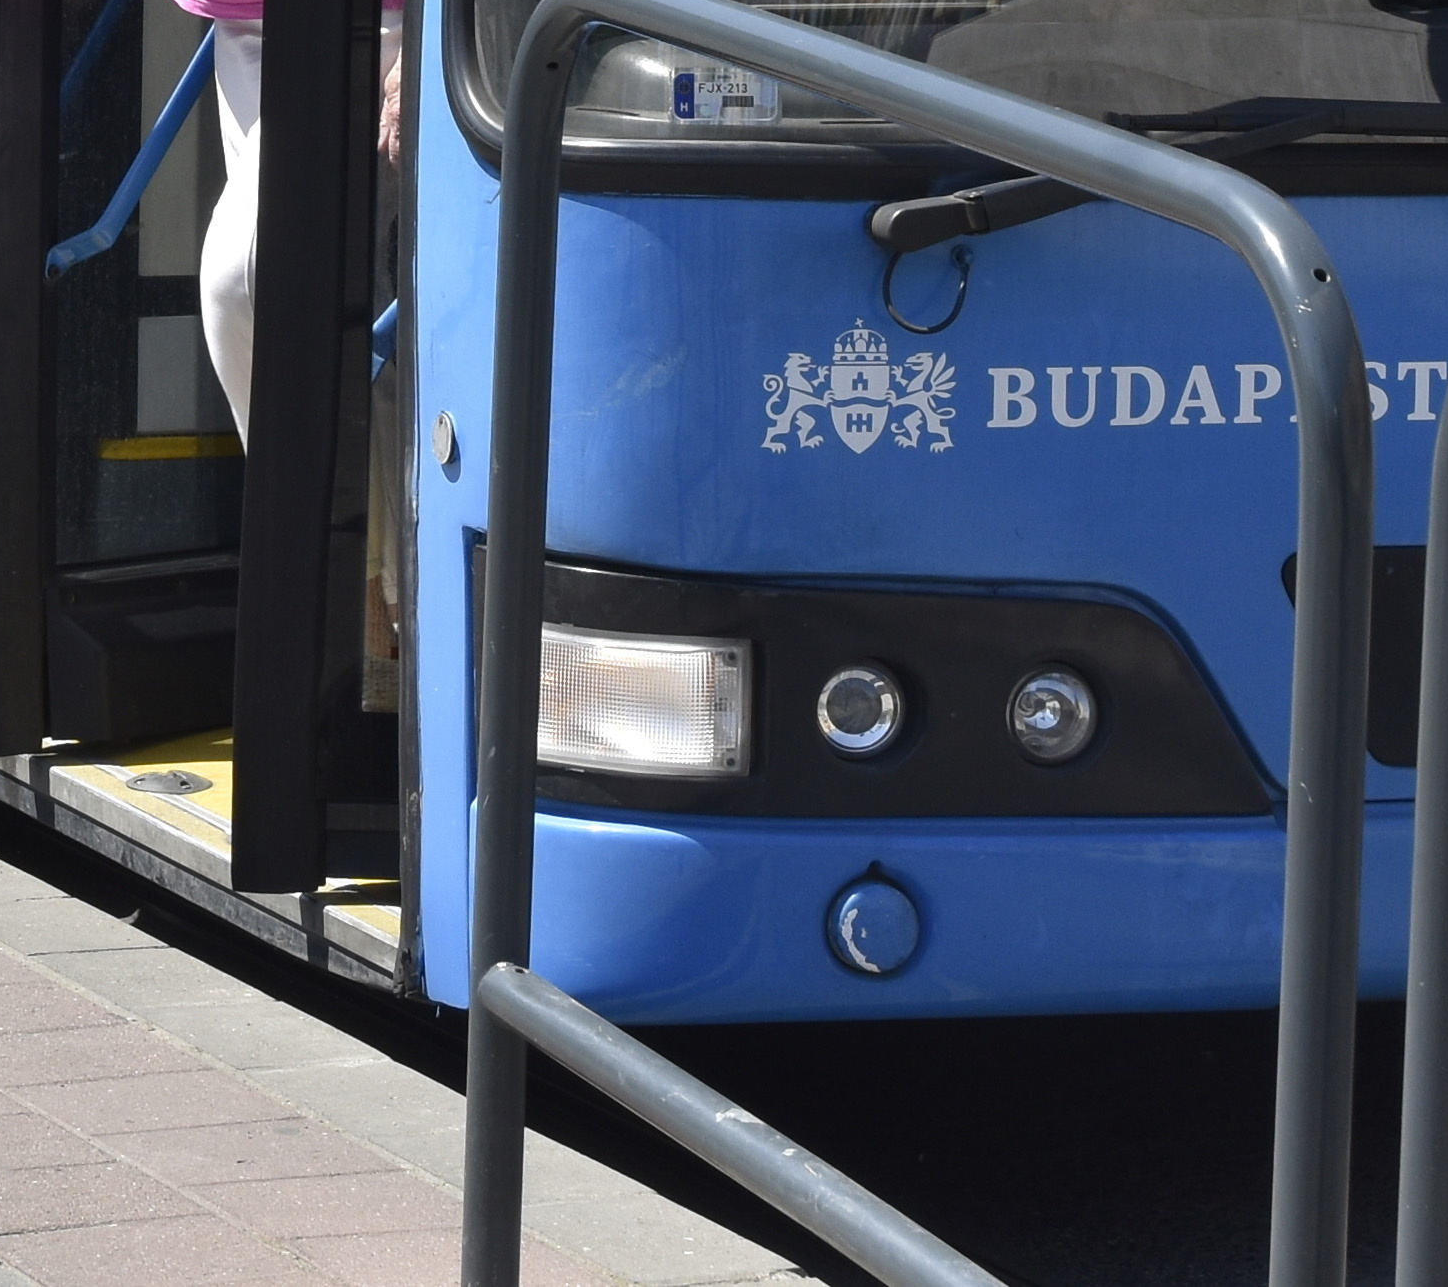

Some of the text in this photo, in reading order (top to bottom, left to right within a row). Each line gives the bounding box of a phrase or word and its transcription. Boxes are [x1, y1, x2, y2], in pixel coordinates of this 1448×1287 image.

[698, 82, 749, 94] FJX-213
[680, 101, 689, 113] H
[986, 360, 1448, 429] BUDAPST
